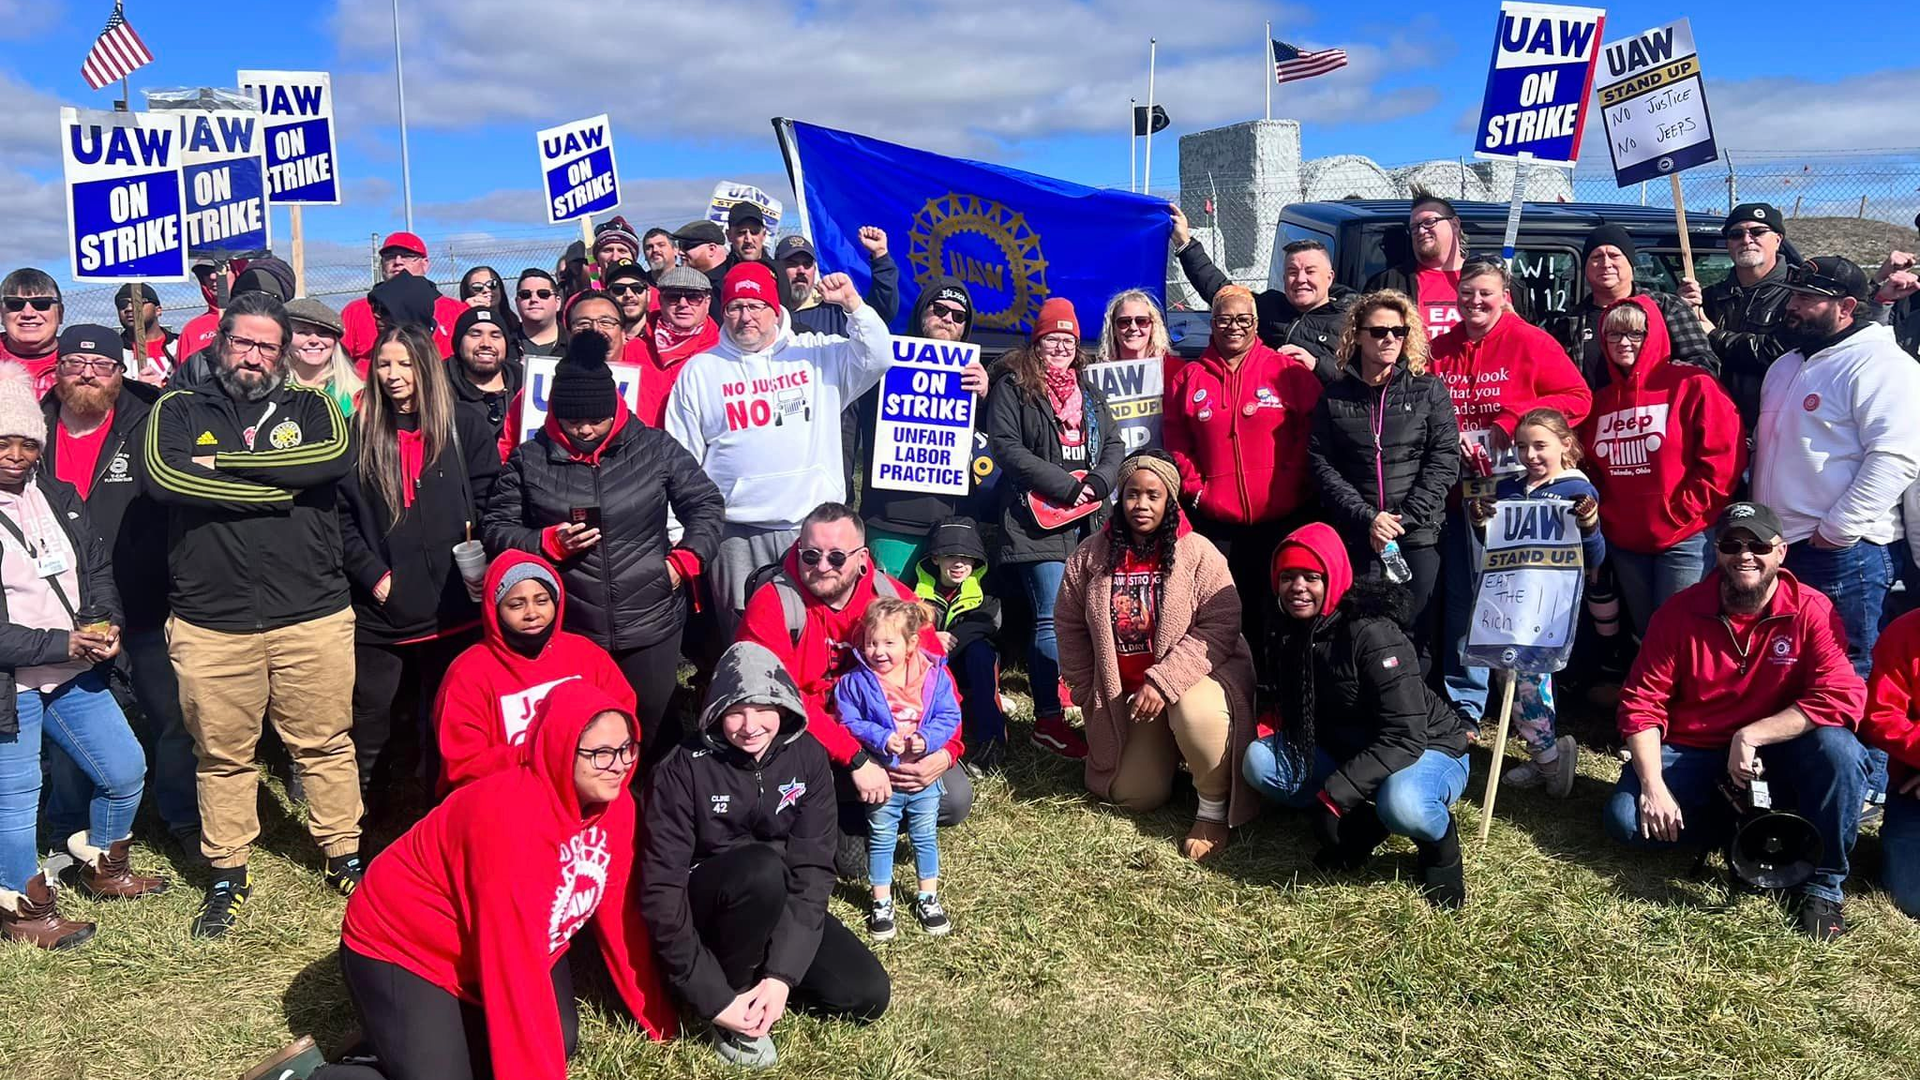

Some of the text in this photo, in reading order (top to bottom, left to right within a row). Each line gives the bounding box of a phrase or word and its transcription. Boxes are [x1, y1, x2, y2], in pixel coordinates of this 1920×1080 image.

[1502, 15, 1596, 58] UAW
[1606, 27, 1674, 77] UAW
[1519, 70, 1559, 107] ON
[1604, 61, 1692, 102] STAND UP
[1485, 102, 1579, 148] STRIKE
[1612, 107, 1631, 127] NO
[1655, 117, 1697, 143] JEEPS
[70, 124, 172, 167] UAW
[181, 115, 255, 153] AW
[275, 127, 305, 160] ON
[543, 125, 604, 159] UAW
[193, 166, 232, 206] ON
[567, 158, 593, 187] ON
[109, 181, 148, 223] ON
[553, 172, 615, 218] STRIKE
[186, 197, 262, 246] TRIKE
[80, 214, 179, 271] STRIKE
[949, 249, 1004, 292] UAW
[1429, 307, 1462, 323] EA
[892, 341, 974, 367] UAW
[722, 370, 809, 397] NO JUSTICE
[912, 371, 947, 395] ON
[1476, 367, 1509, 383] look
[884, 393, 970, 421] STRIKE
[1450, 386, 1501, 401] hat you
[725, 398, 771, 432] NO
[1137, 401, 1160, 414] UP
[1454, 402, 1501, 415] ade me
[893, 426, 956, 447] UNFAIR
[1602, 414, 1653, 434] Jeep
[894, 446, 951, 466] LABOR
[879, 464, 963, 486] PRACTICE
[1504, 505, 1567, 542] UAW
[1488, 550, 1577, 567] STAND UP
[1113, 575, 1161, 586] AW STROG
[1484, 573, 1516, 589] EAT
[1495, 589, 1526, 603] THE
[1481, 611, 1513, 631] Rich
[711, 795, 731, 803] CLINE
[712, 803, 728, 814] 42
[562, 886, 596, 923] AW
